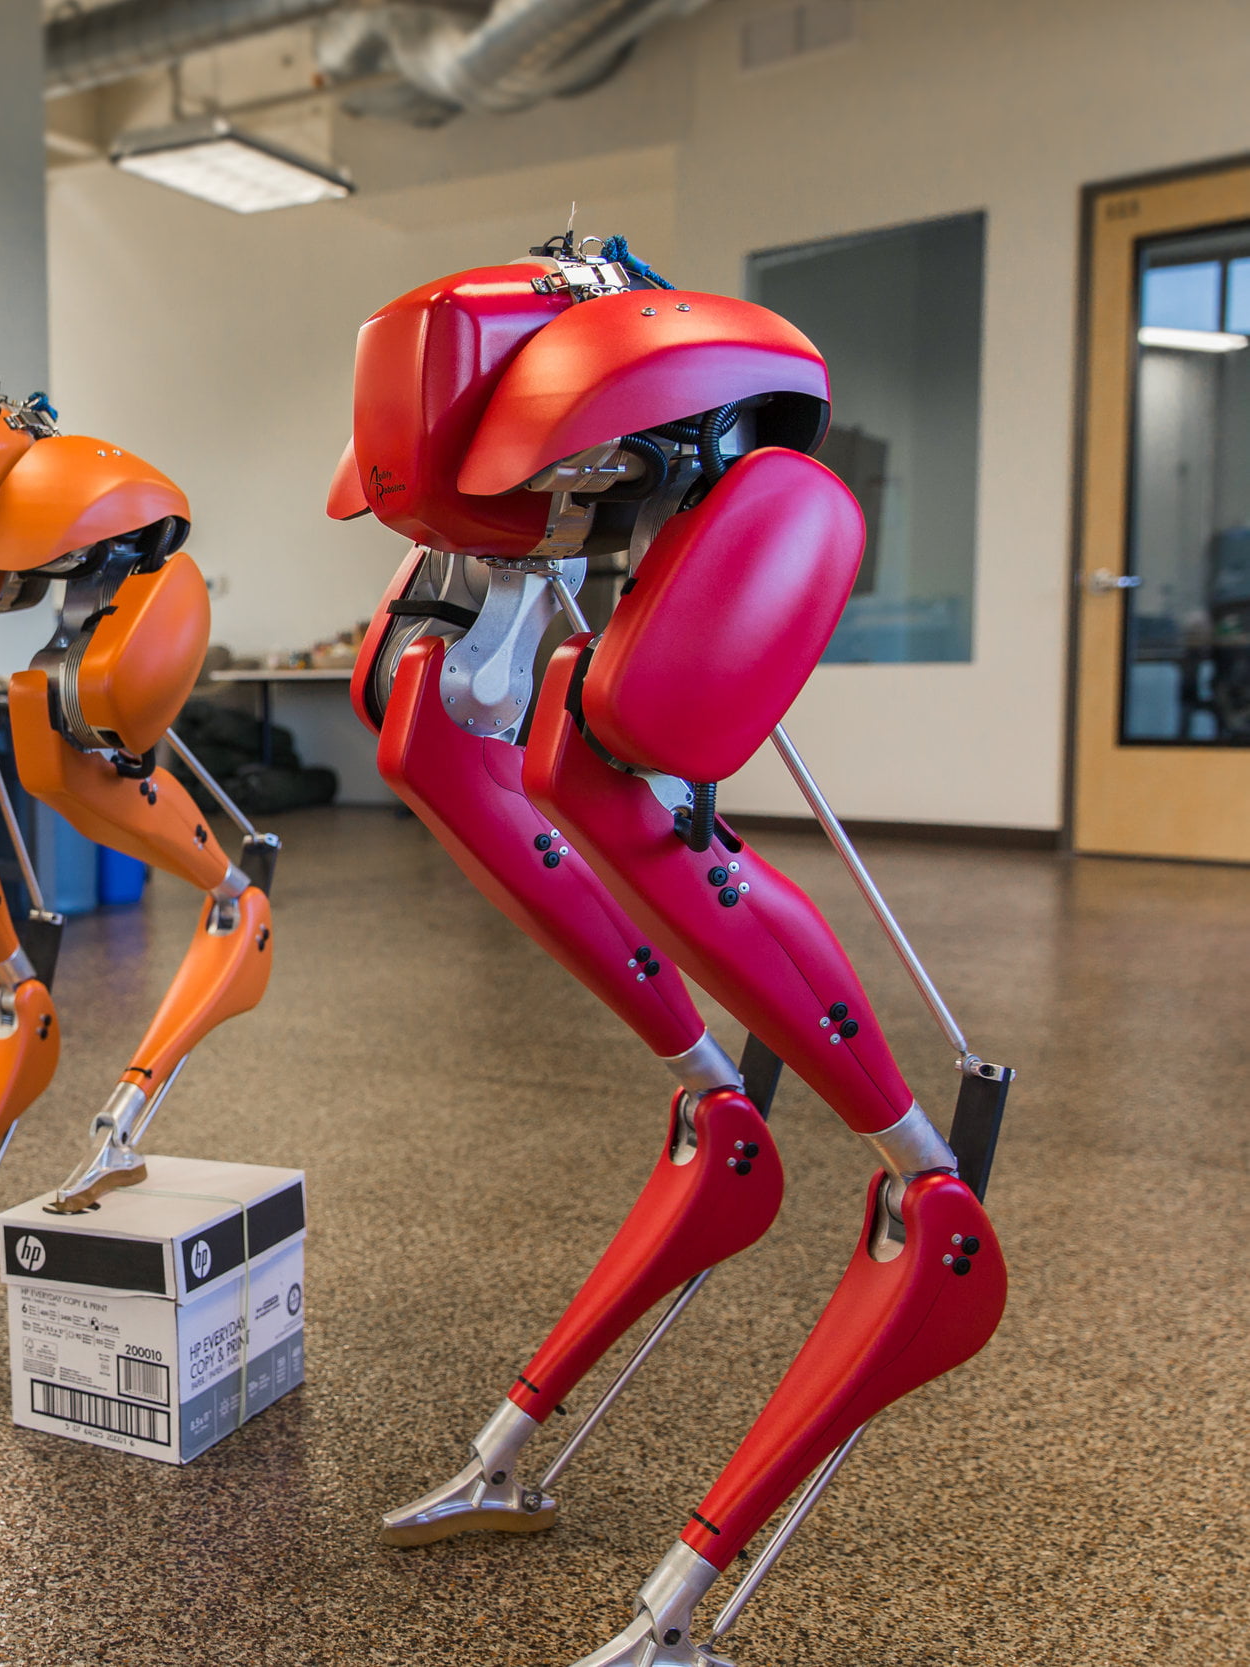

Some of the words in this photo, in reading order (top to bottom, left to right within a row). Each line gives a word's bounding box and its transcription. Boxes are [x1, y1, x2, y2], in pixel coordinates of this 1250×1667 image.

[376, 483, 406, 506] Robotics
[19, 1235, 43, 1271] hp
[193, 1240, 210, 1278] hp
[21, 1288, 29, 1296] HP
[31, 1289, 62, 1304] EVERYDAY
[63, 1296, 81, 1307] COPY
[125, 1344, 162, 1361] 200010
[190, 1342, 201, 1361] HP
[191, 1351, 215, 1378] COPY
[218, 1347, 224, 1362] &
